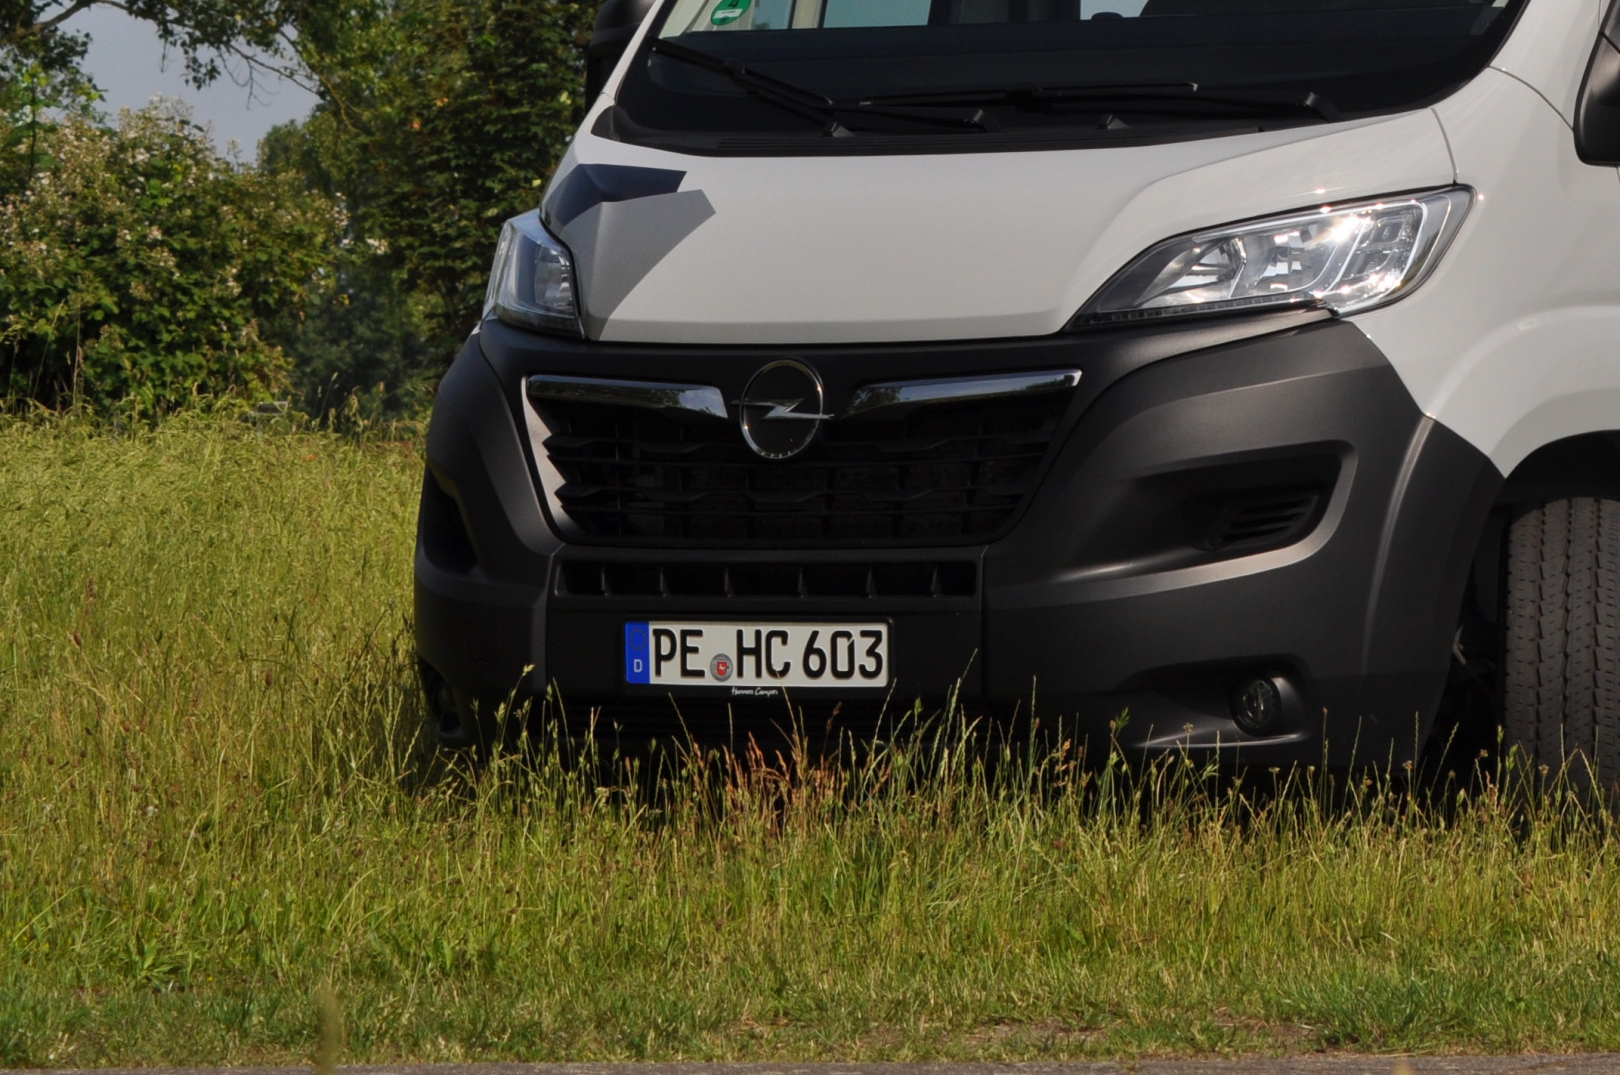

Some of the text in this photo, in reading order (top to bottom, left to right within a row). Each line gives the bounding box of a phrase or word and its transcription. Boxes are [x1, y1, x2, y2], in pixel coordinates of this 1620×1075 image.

[633, 658, 643, 673] D
[652, 628, 884, 680] PE HC 603
